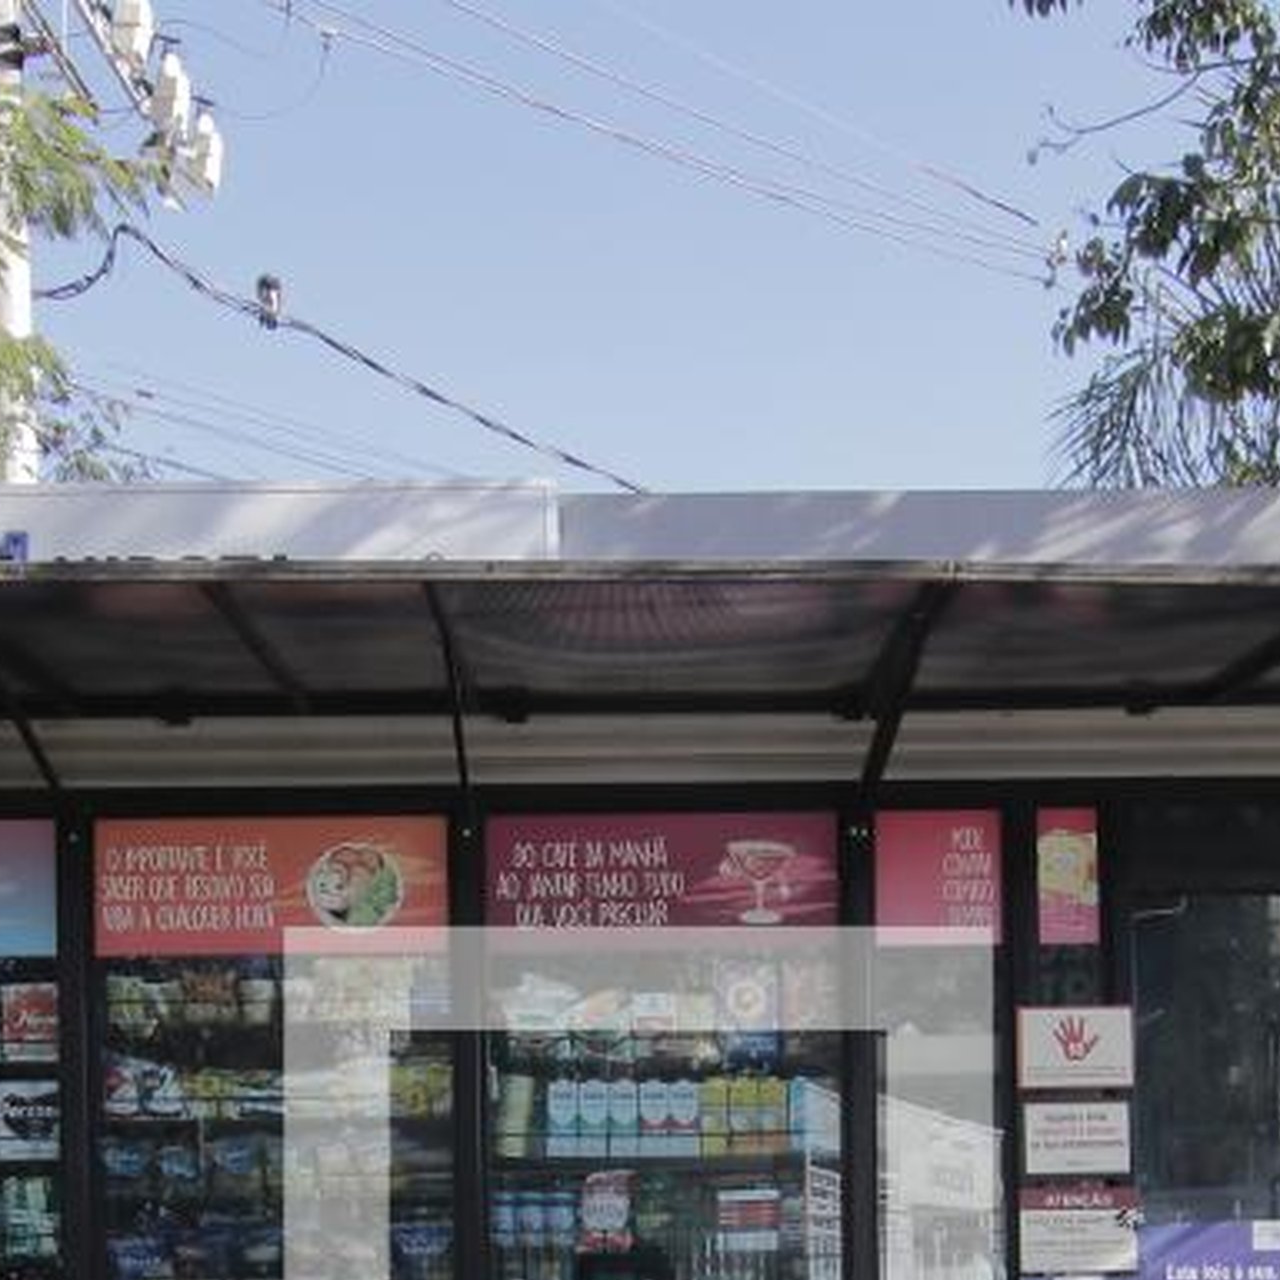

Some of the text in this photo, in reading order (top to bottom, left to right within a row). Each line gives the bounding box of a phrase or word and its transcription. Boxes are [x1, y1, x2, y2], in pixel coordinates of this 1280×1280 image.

[609, 836, 668, 868] MANHÃ
[496, 871, 520, 900] AO
[1166, 1262, 1198, 1280] Esta
[1247, 1265, 1278, 1280] sua.
